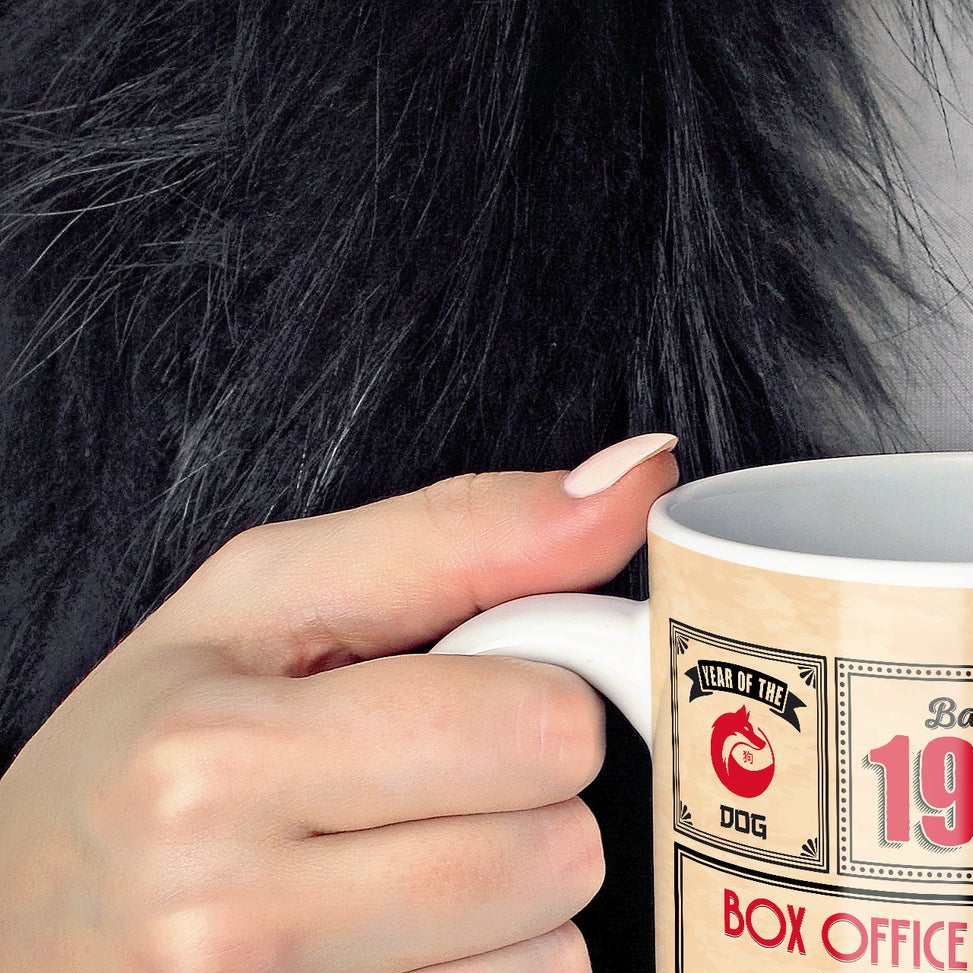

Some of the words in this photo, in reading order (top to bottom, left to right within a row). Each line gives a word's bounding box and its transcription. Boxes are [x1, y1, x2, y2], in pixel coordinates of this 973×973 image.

[701, 665, 734, 689] YEAR
[737, 670, 753, 693] OF
[758, 677, 785, 707] THE
[719, 804, 767, 840] DOG
[723, 887, 807, 956] BOX
[820, 911, 968, 971] OFFICE
